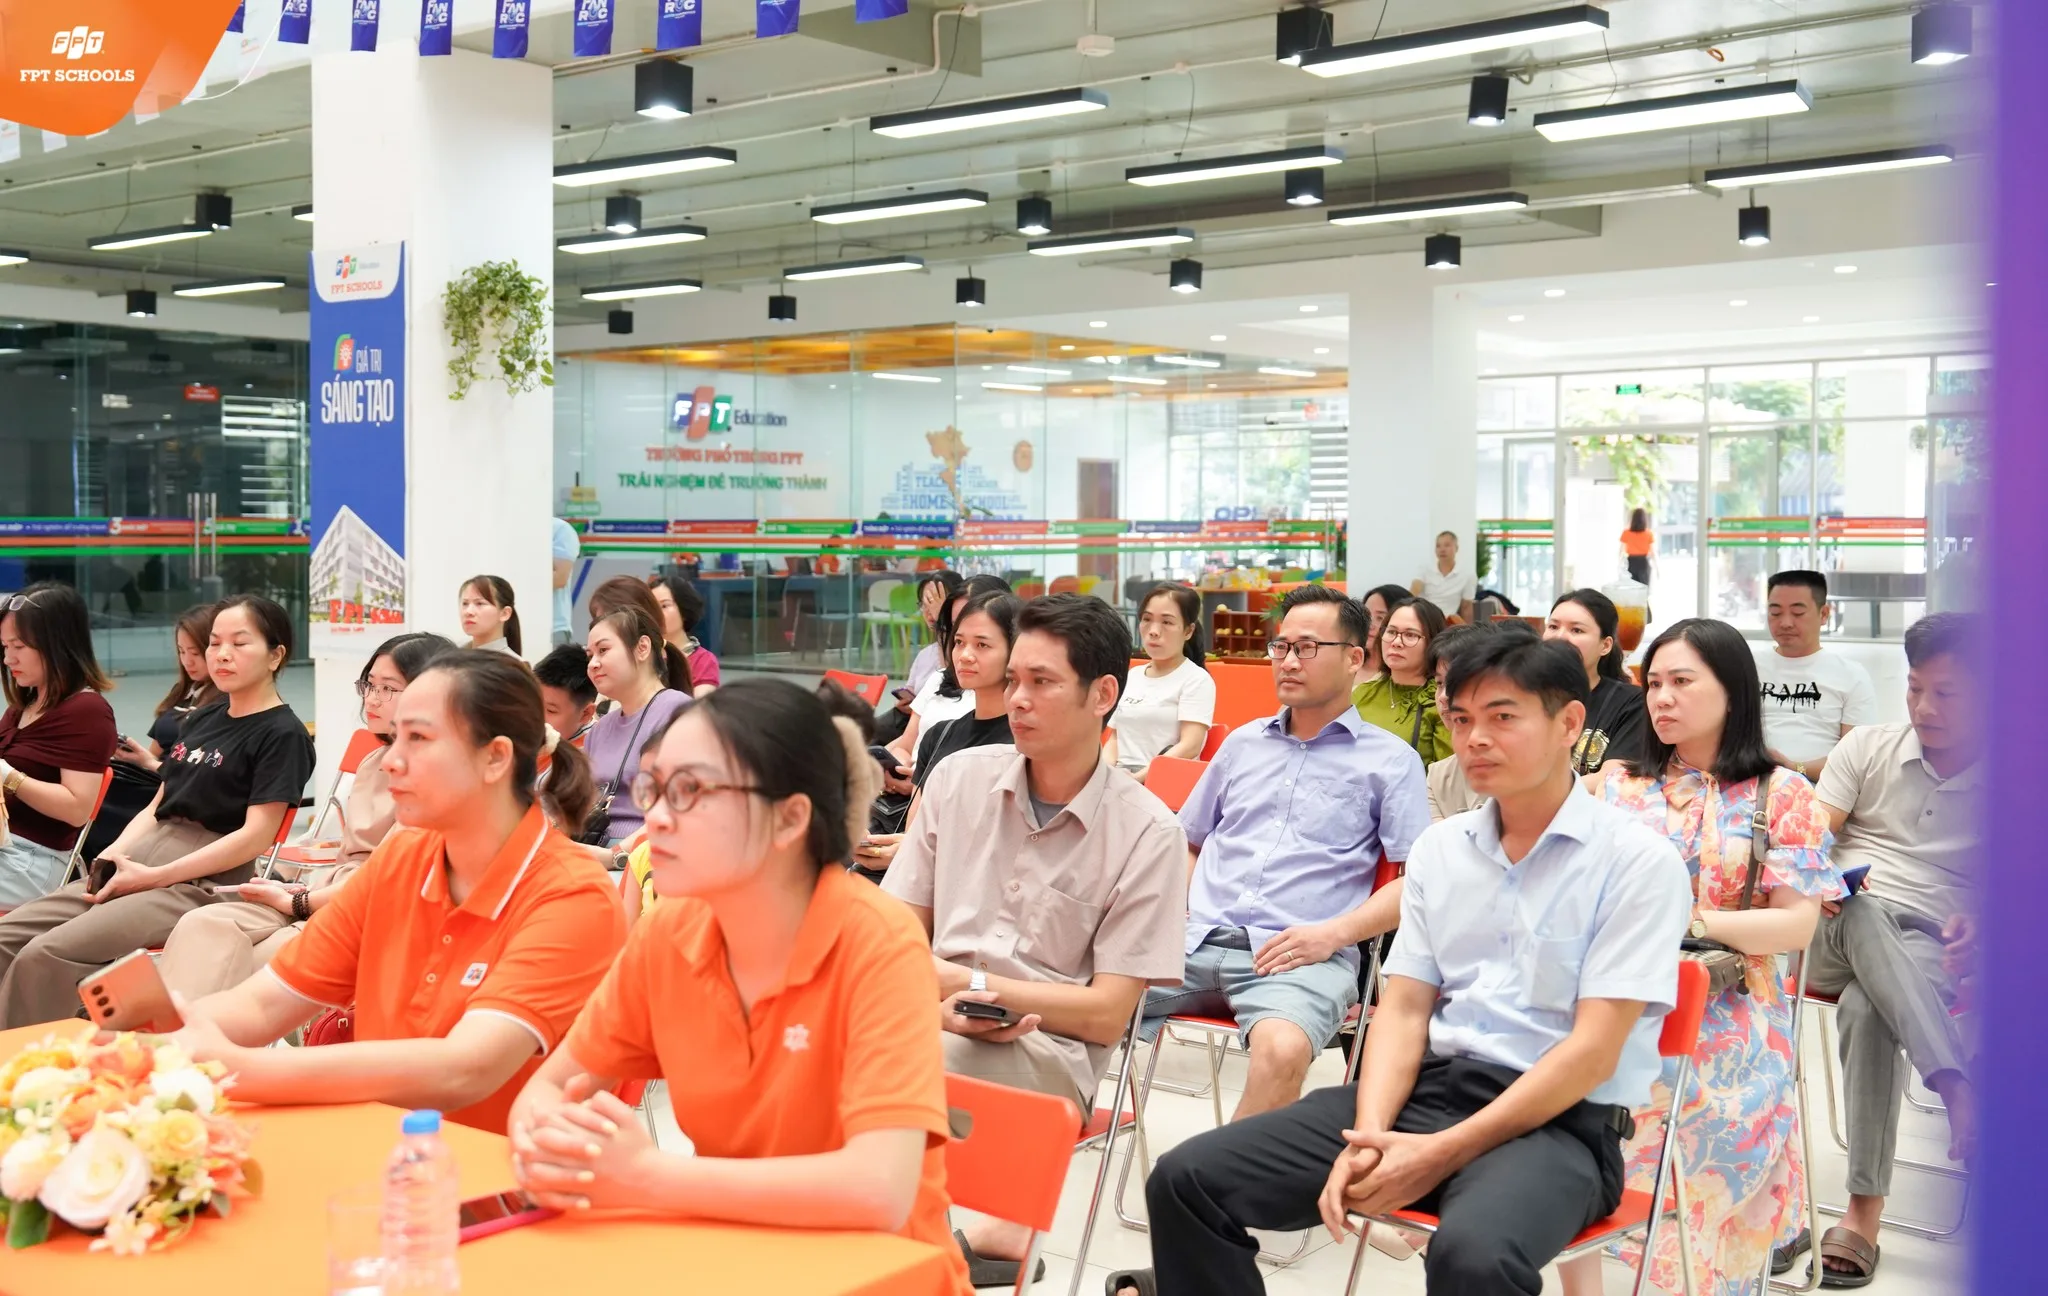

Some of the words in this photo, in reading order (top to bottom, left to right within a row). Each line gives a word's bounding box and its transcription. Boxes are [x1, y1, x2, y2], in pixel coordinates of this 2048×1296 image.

[346, 280, 383, 293] SCHOOLS
[356, 346, 368, 373] GIÁ
[370, 349, 382, 374] TRỊ
[321, 374, 364, 424] SÁNG
[365, 379, 395, 427] TẠO
[734, 409, 787, 427] Education
[781, 452, 804, 465] FPT
[1759, 681, 1821, 701] RADA
